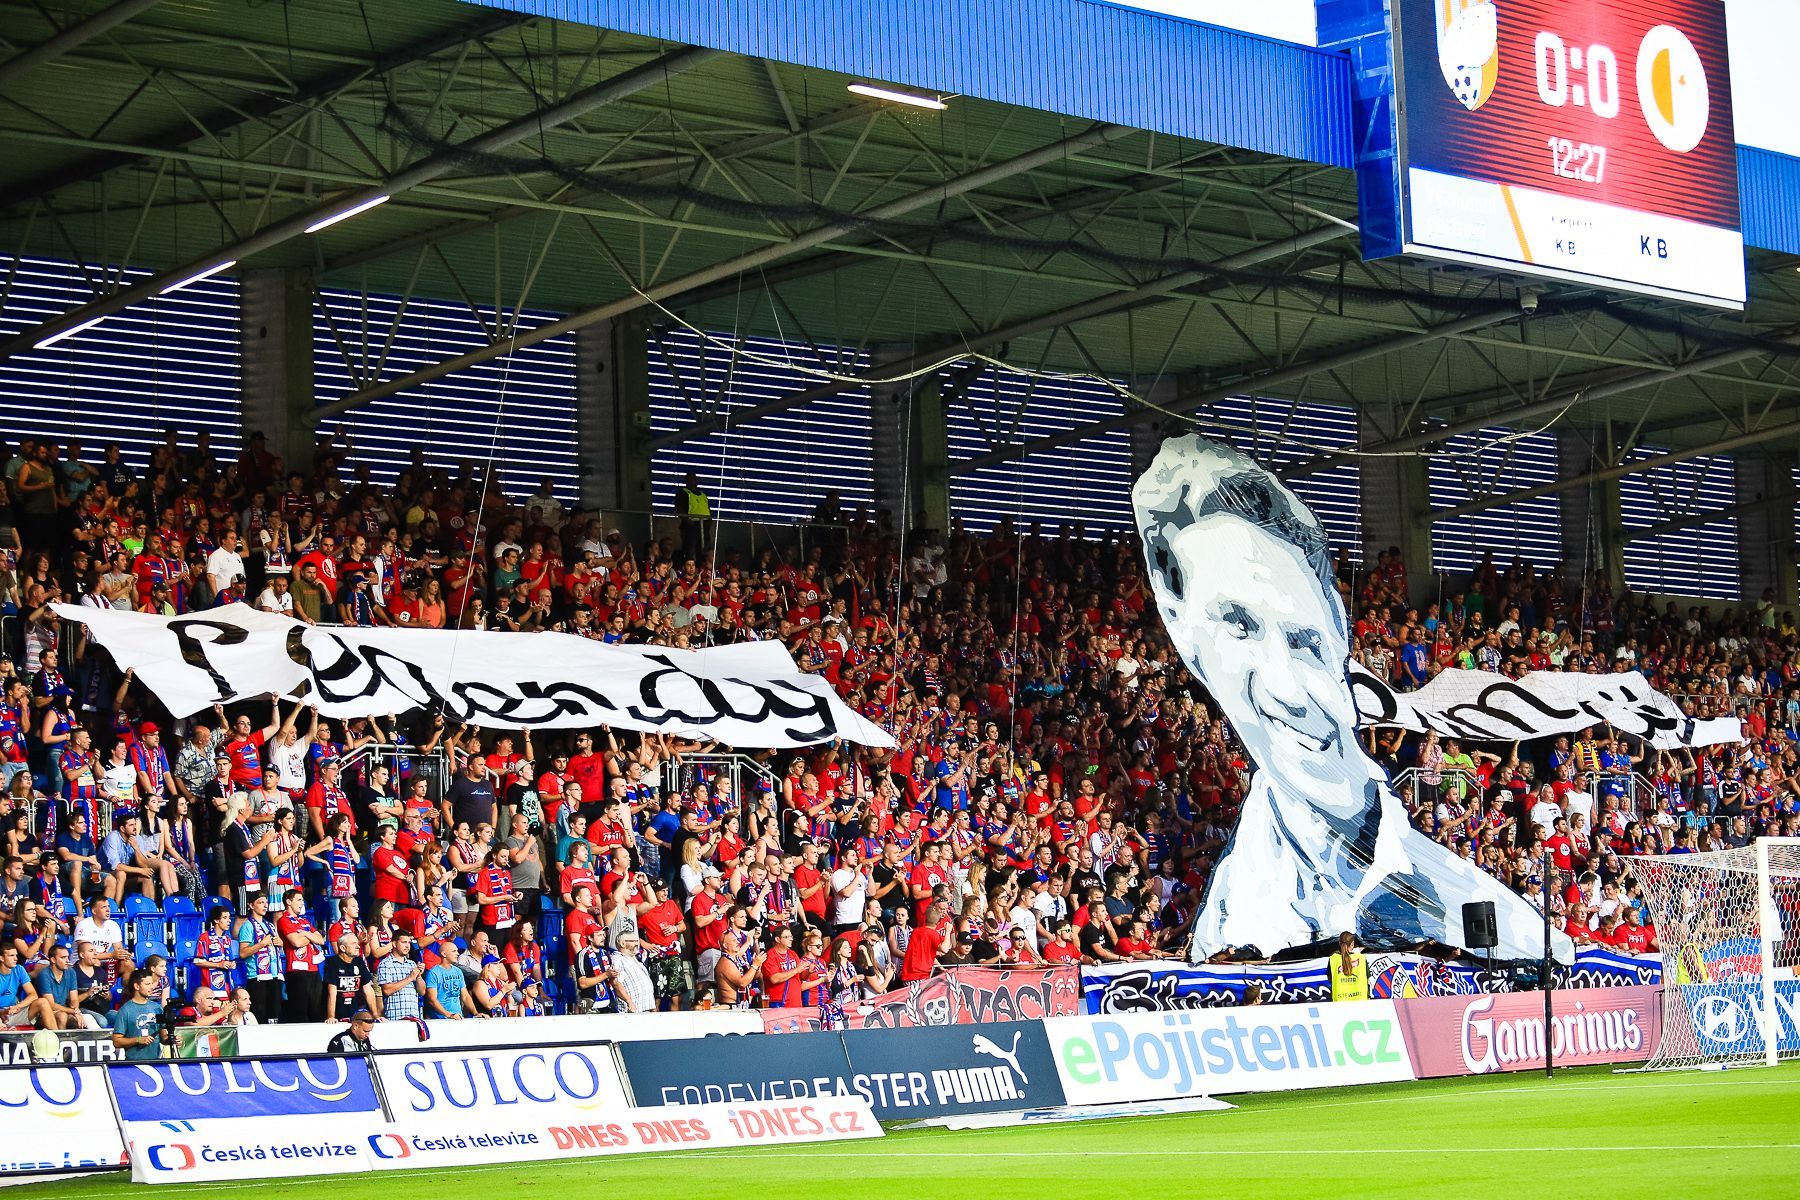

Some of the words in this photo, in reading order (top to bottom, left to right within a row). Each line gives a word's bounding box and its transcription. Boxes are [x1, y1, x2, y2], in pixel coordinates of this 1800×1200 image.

[1535, 31, 1620, 119] 0:0
[1547, 136, 1606, 184] 12:27
[1062, 1006, 1402, 1094] ePojisteni.cz
[1461, 993, 1643, 1074] Gambrinus
[404, 1051, 600, 1112] SULCO
[931, 1065, 1019, 1106] PUMA
[271, 1141, 358, 1160] televize
[469, 1130, 539, 1149] televize
[548, 1122, 629, 1150] DNES
[633, 1117, 712, 1145] DNES
[728, 1105, 865, 1140] iDNES.cz
